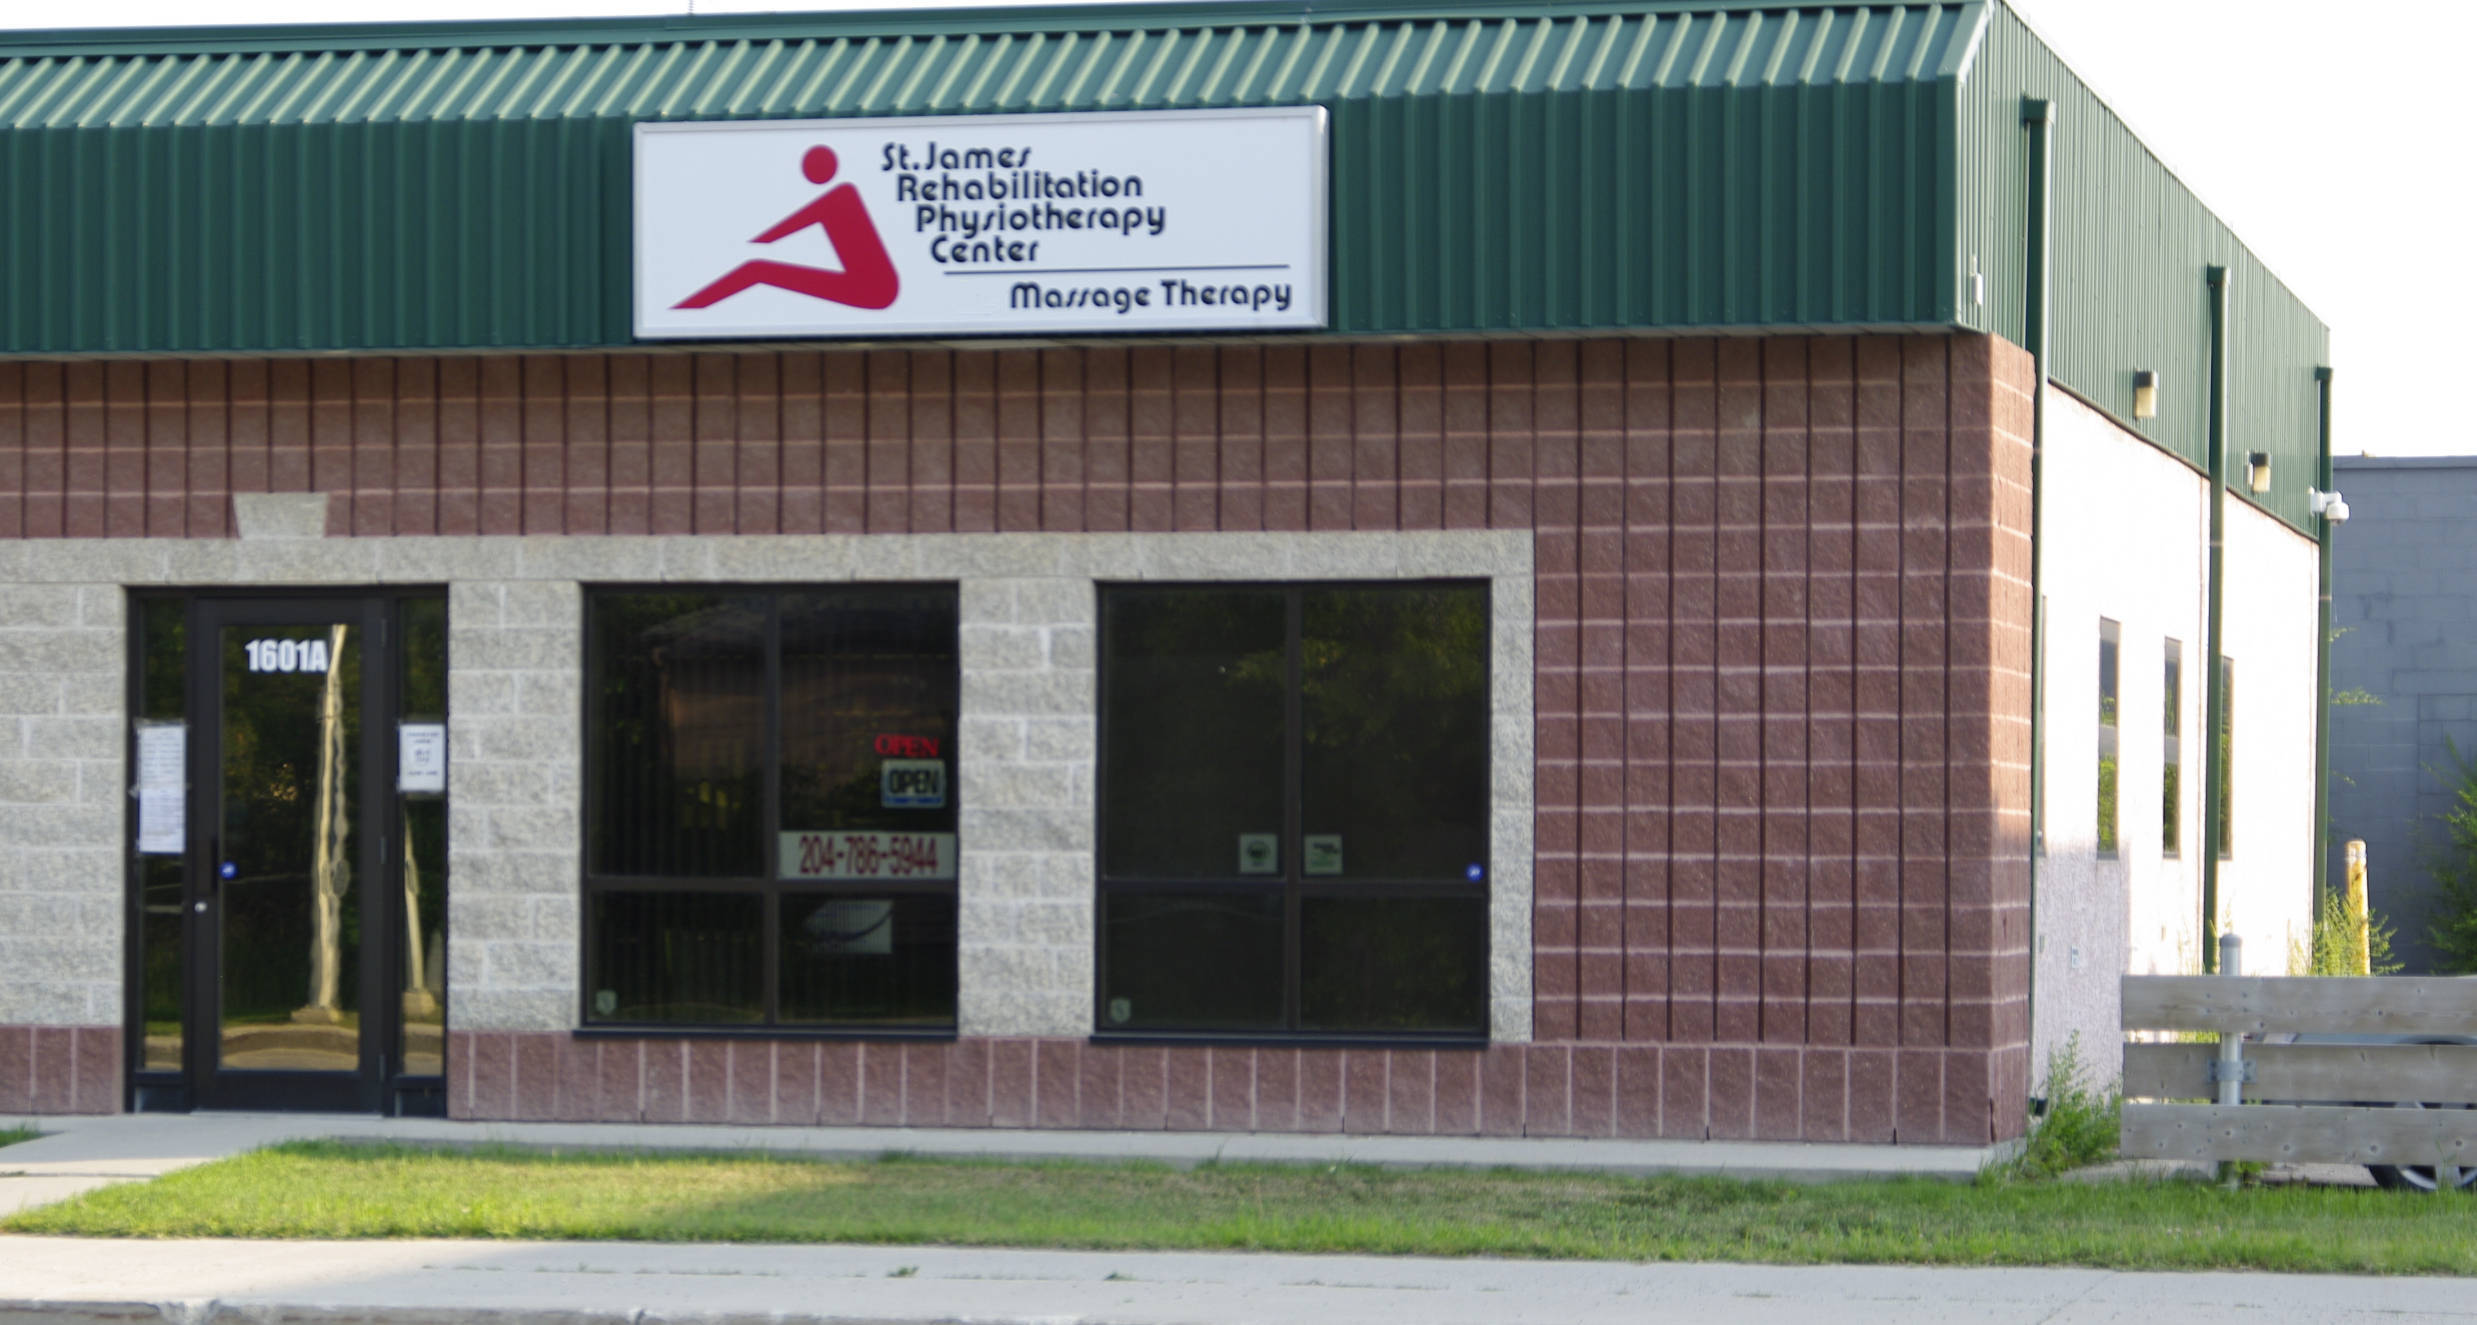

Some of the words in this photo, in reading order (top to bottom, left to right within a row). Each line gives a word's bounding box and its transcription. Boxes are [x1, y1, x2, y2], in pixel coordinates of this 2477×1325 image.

[897, 170, 1143, 202] Rehabilitation
[916, 203, 1166, 239] Physiotherapy
[930, 235, 1039, 264] Center
[1010, 282, 1150, 315] Massage
[1160, 279, 1292, 312] Therapy
[245, 639, 328, 672] 1601A
[875, 734, 939, 757] OPEN
[889, 769, 939, 795] OPEN
[799, 835, 938, 876] 204-786-5944
